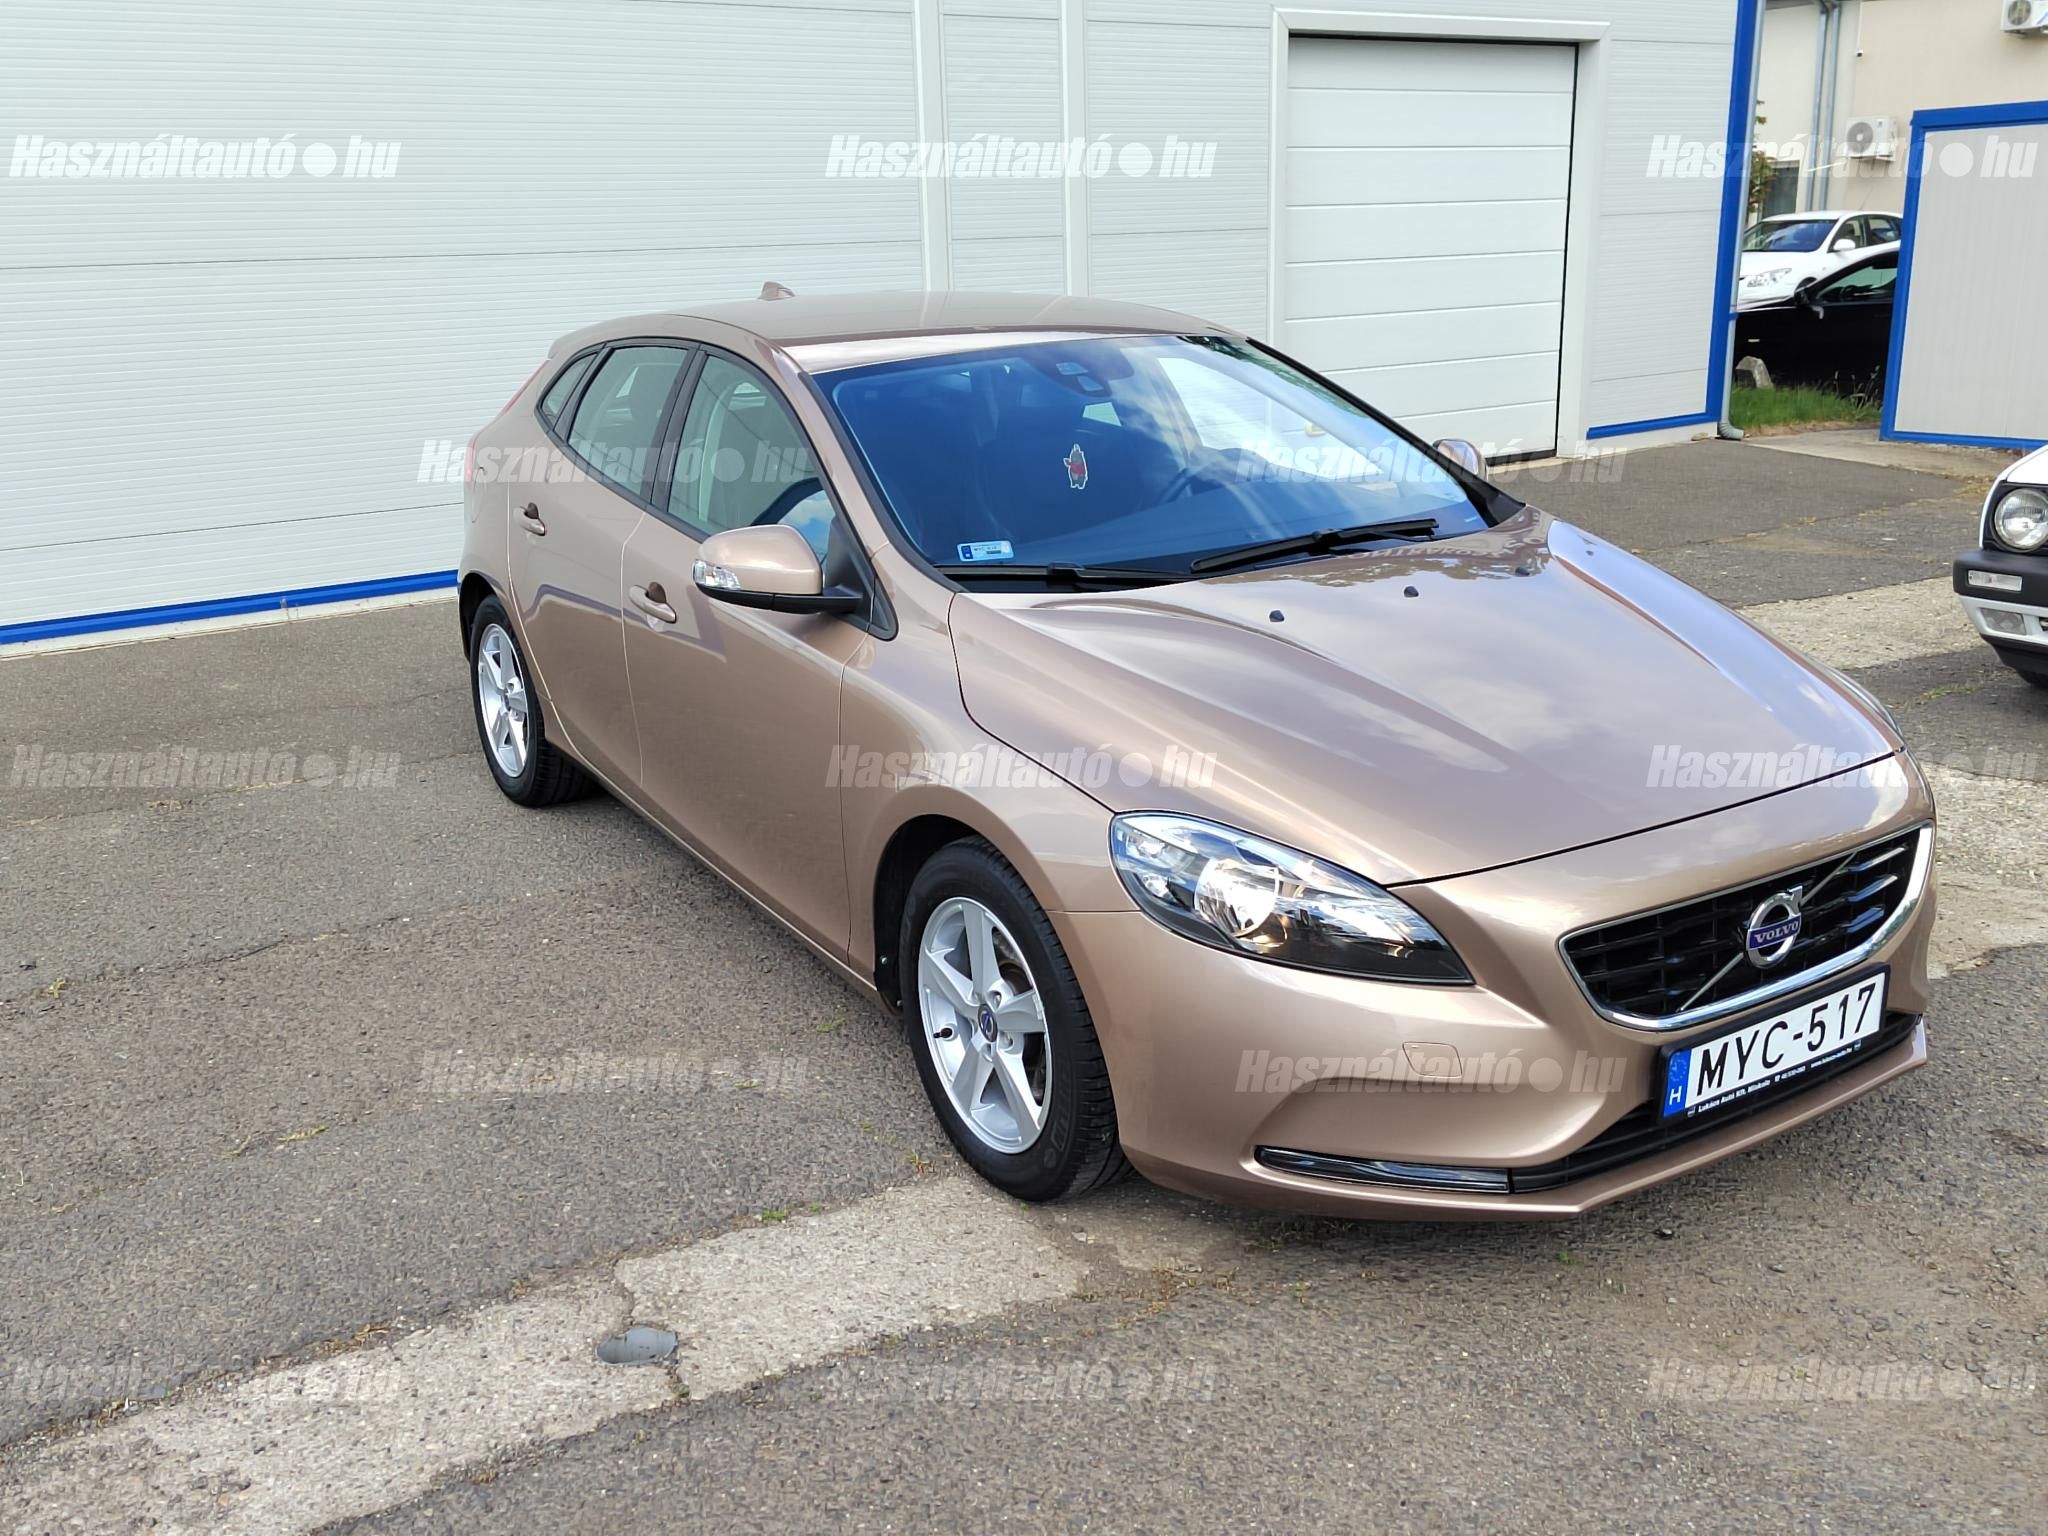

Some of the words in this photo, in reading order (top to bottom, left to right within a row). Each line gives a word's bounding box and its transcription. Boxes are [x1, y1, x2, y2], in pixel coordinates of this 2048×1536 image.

[1754, 920, 1799, 943] VOLVO
[1696, 982, 1877, 1097] MYC-517
[1668, 1085, 1683, 1106] H
